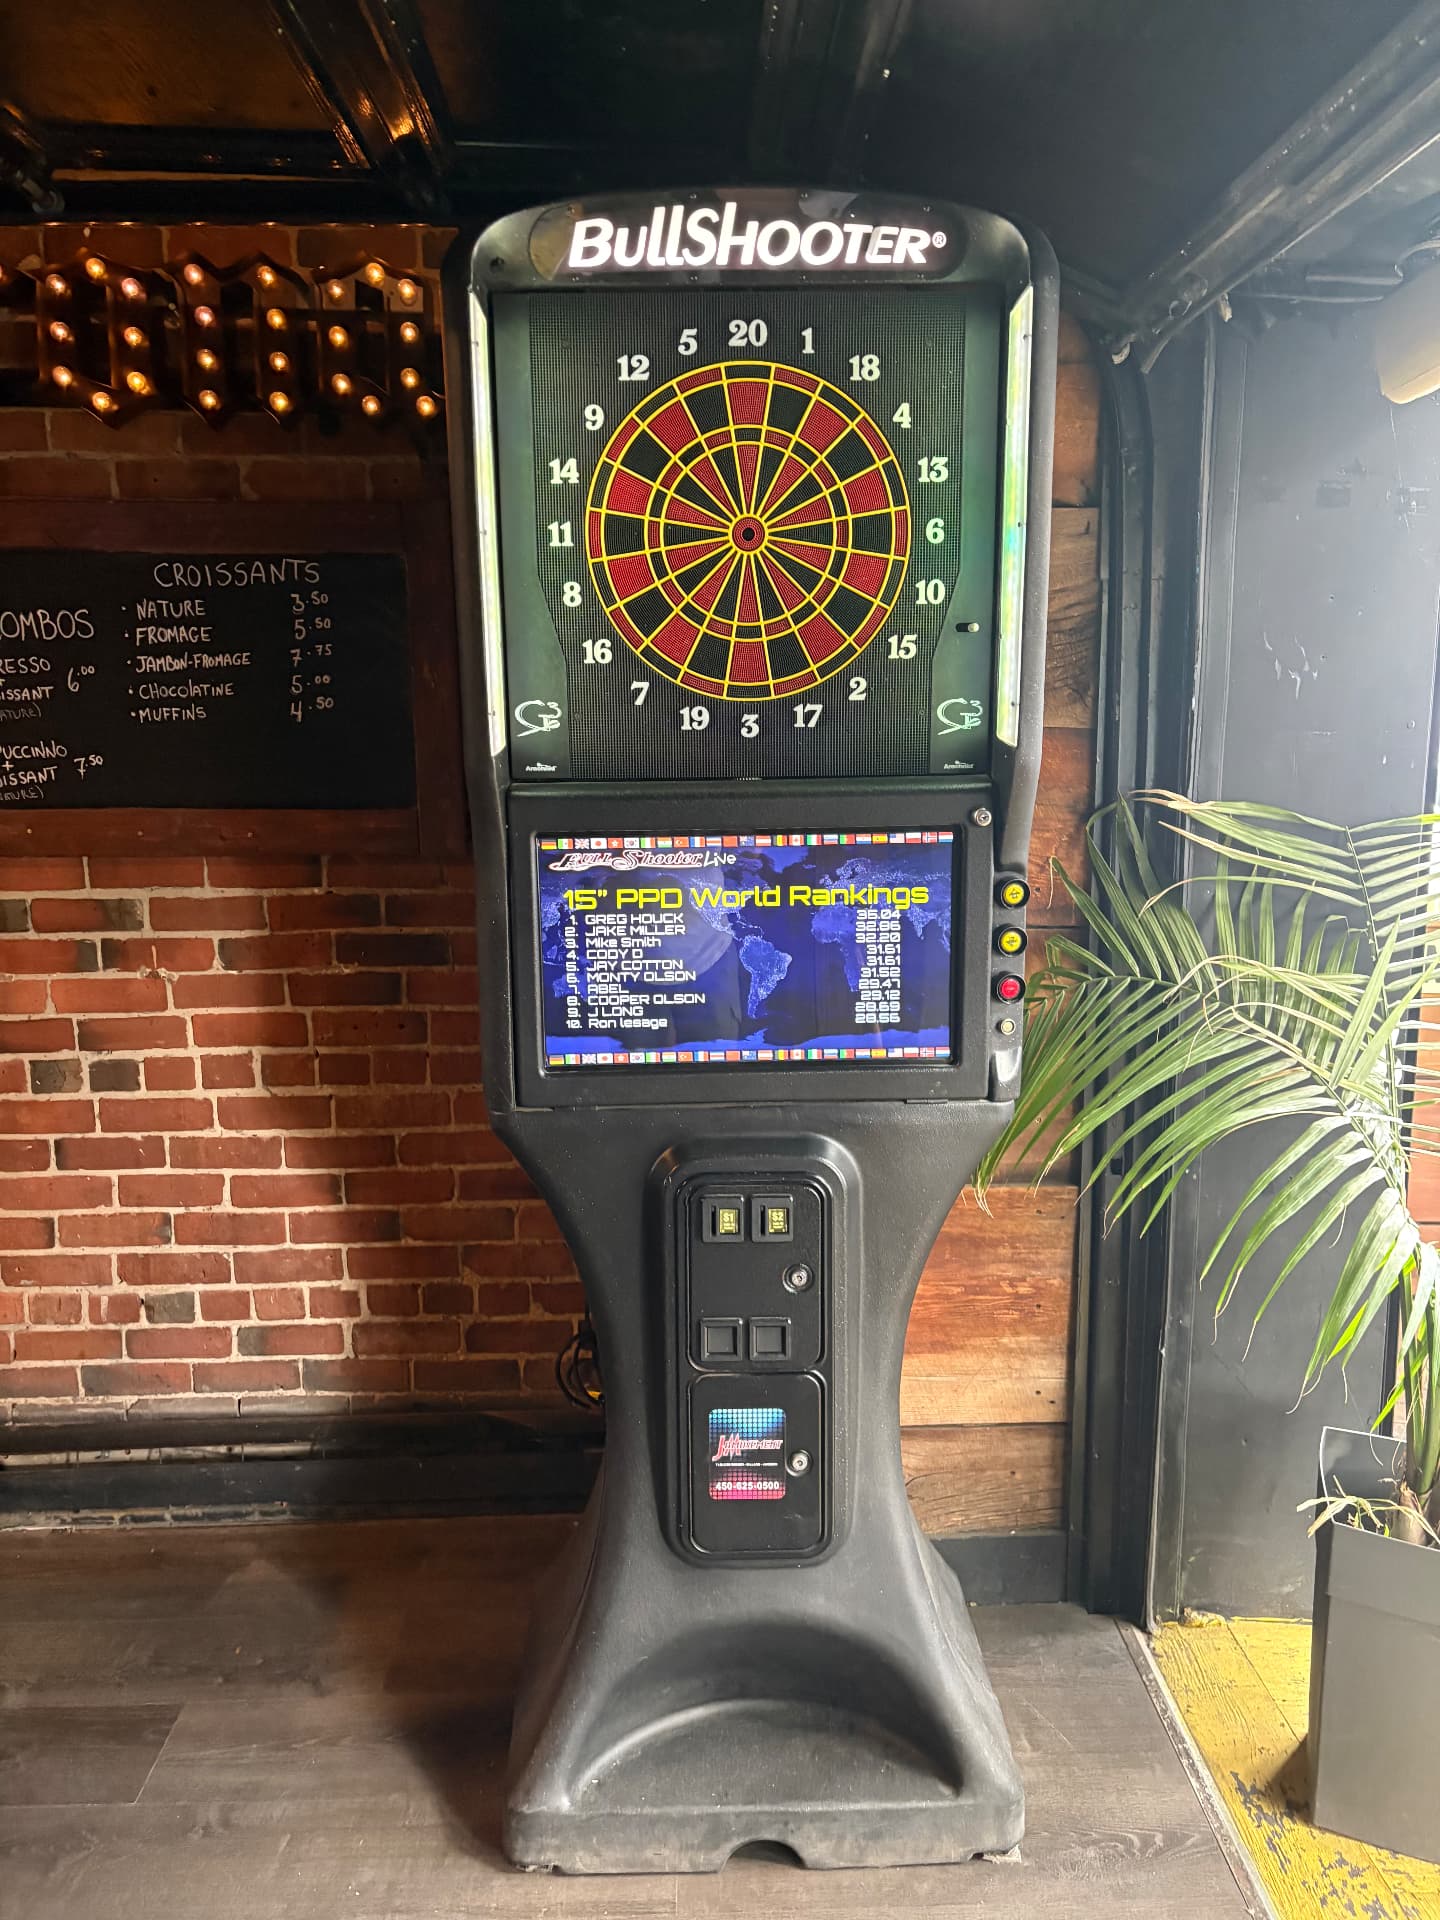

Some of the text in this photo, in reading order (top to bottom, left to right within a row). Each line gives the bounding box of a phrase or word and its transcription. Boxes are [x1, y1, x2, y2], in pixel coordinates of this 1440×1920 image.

[678, 328, 698, 355] 5
[729, 319, 767, 347] 20
[801, 327, 815, 354] 1
[616, 354, 650, 381] 12
[848, 354, 881, 382] 18
[584, 403, 604, 431] 9
[892, 402, 912, 429] 4
[548, 456, 580, 485] 14
[917, 456, 949, 484] 13
[547, 521, 575, 549] 11
[925, 517, 945, 545] 6
[153, 558, 320, 588] CROISSANTS
[562, 580, 583, 608] 8
[915, 578, 946, 606] 10
[136, 598, 207, 620] NATURE
[0, 609, 95, 641] OMBOS
[136, 618, 332, 647] FROMAGE 5.50
[136, 644, 333, 674] JAMBON-FROMAGE 7.75
[582, 638, 613, 665] 16
[887, 633, 919, 660] 15
[0, 685, 54, 701] ISSANT
[138, 679, 234, 700] CHOCOLATINE
[630, 680, 650, 706] 7
[848, 676, 867, 701] 2
[138, 703, 207, 724] MUFFINS
[679, 705, 710, 731] 19
[740, 713, 760, 738] 3
[793, 703, 823, 728] 17
[0, 740, 68, 759] UCCINNO
[703, 850, 737, 867] Live
[616, 887, 683, 909] PPD
[690, 885, 781, 909] World
[789, 884, 930, 910] Rankings
[564, 927, 578, 937] 2.
[585, 925, 627, 936] JAKE
[630, 925, 686, 935] MILLER
[569, 915, 578, 925] 1.
[585, 914, 627, 925] GREG
[630, 913, 684, 924] HOUCK
[565, 938, 579, 948] 3.
[585, 936, 618, 948] Mike
[621, 936, 662, 947] Smith
[566, 950, 579, 960] 4.
[586, 949, 628, 959] CODY
[565, 962, 579, 972] 5.
[586, 961, 618, 971] JAY
[621, 960, 684, 970] COTTON
[566, 973, 580, 983] 6.
[586, 972, 641, 983] MONTY
[644, 971, 696, 981] OLSON
[566, 995, 581, 1006] 8.
[587, 995, 650, 1005] COOPER
[653, 993, 706, 1004] OLSON
[568, 984, 581, 994] 7.
[587, 984, 629, 994] ABEL
[566, 1020, 583, 1029] 10.
[588, 1018, 617, 1029] Ron
[620, 1018, 668, 1030] lesage
[567, 1007, 581, 1018] 9.
[587, 1007, 599, 1017] J
[601, 1006, 644, 1017] LONG
